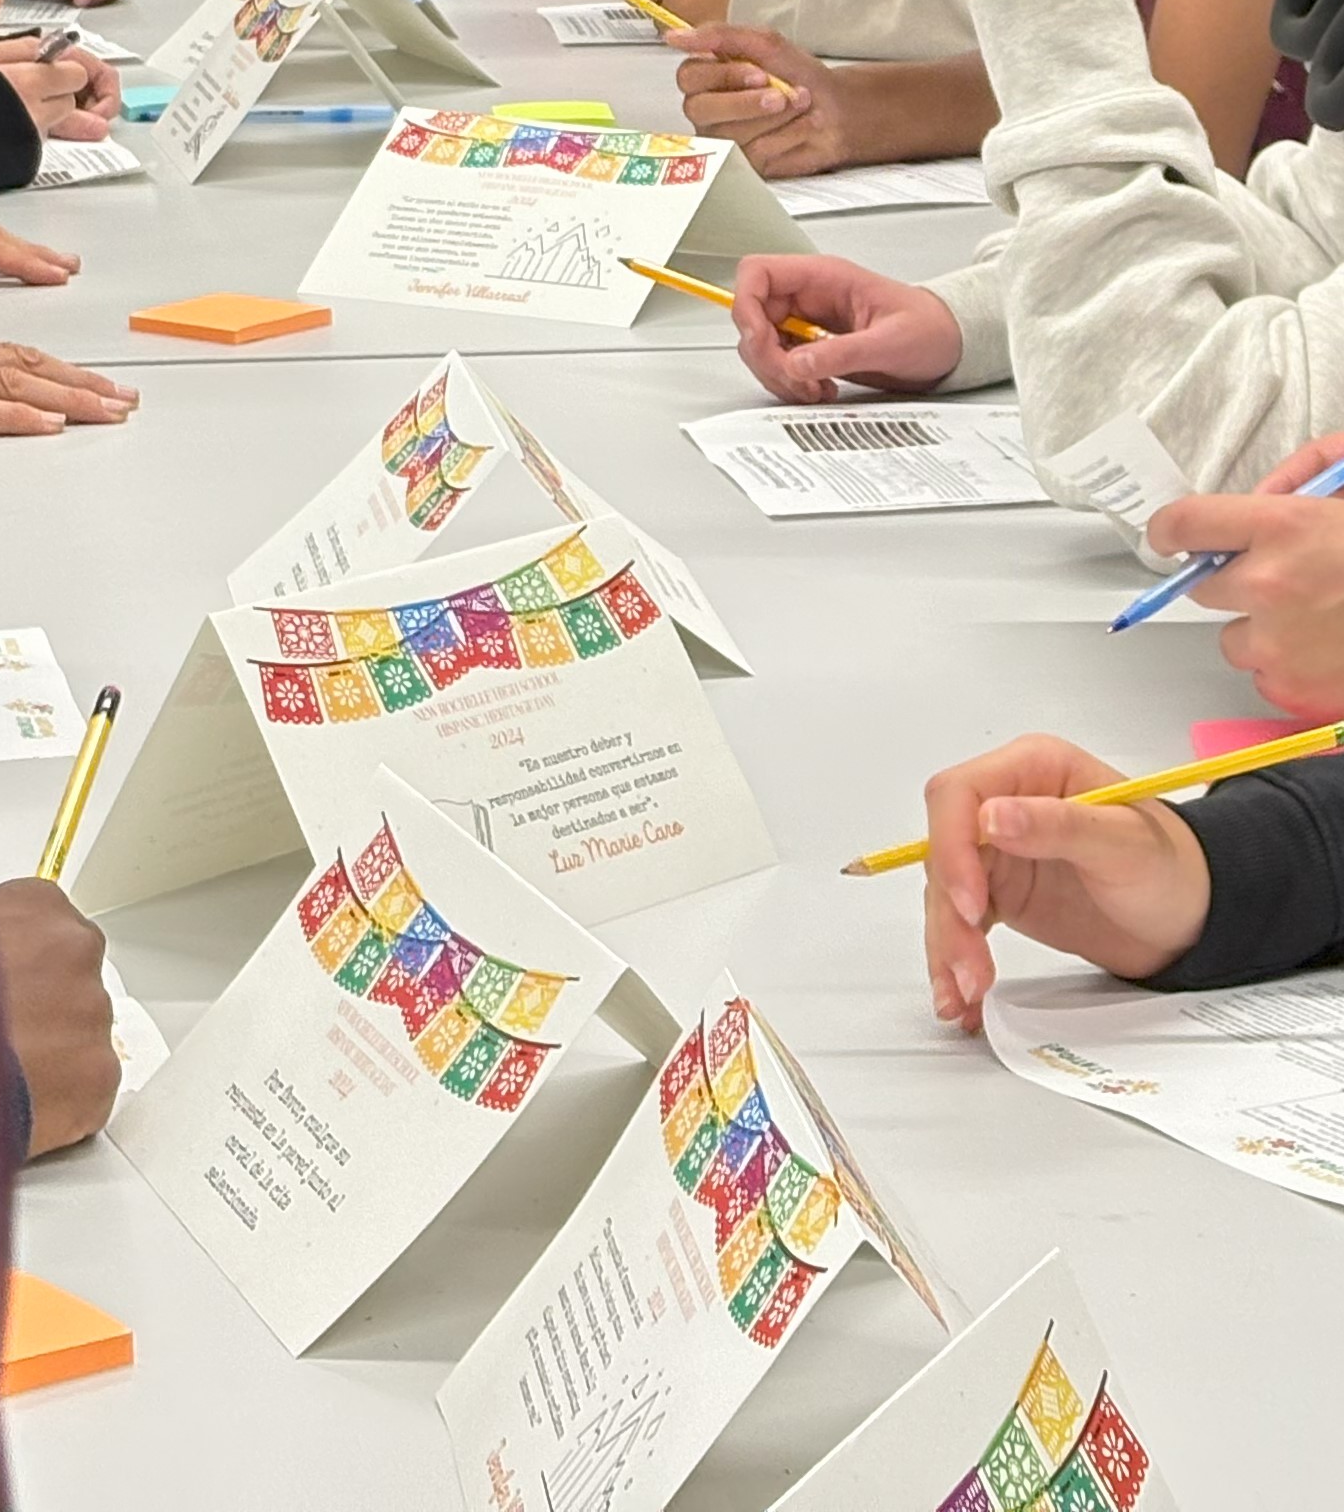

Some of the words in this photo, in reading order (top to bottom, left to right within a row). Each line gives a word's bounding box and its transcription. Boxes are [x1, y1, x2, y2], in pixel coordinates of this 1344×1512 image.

[489, 727, 525, 750] 2024
[542, 744, 590, 767] nuestro
[590, 734, 622, 754] deber
[622, 731, 633, 746] y
[487, 767, 587, 809] responsabilidad
[588, 746, 667, 778] convertirnos
[667, 742, 682, 755] en
[509, 812, 527, 827] la
[527, 802, 560, 823] mejor
[563, 789, 610, 814] persona
[611, 780, 633, 798] que
[634, 767, 679, 789] estamos
[548, 849, 585, 873] Luz
[642, 819, 685, 843] Caro
[551, 812, 618, 839] destinados
[619, 808, 629, 818] a
